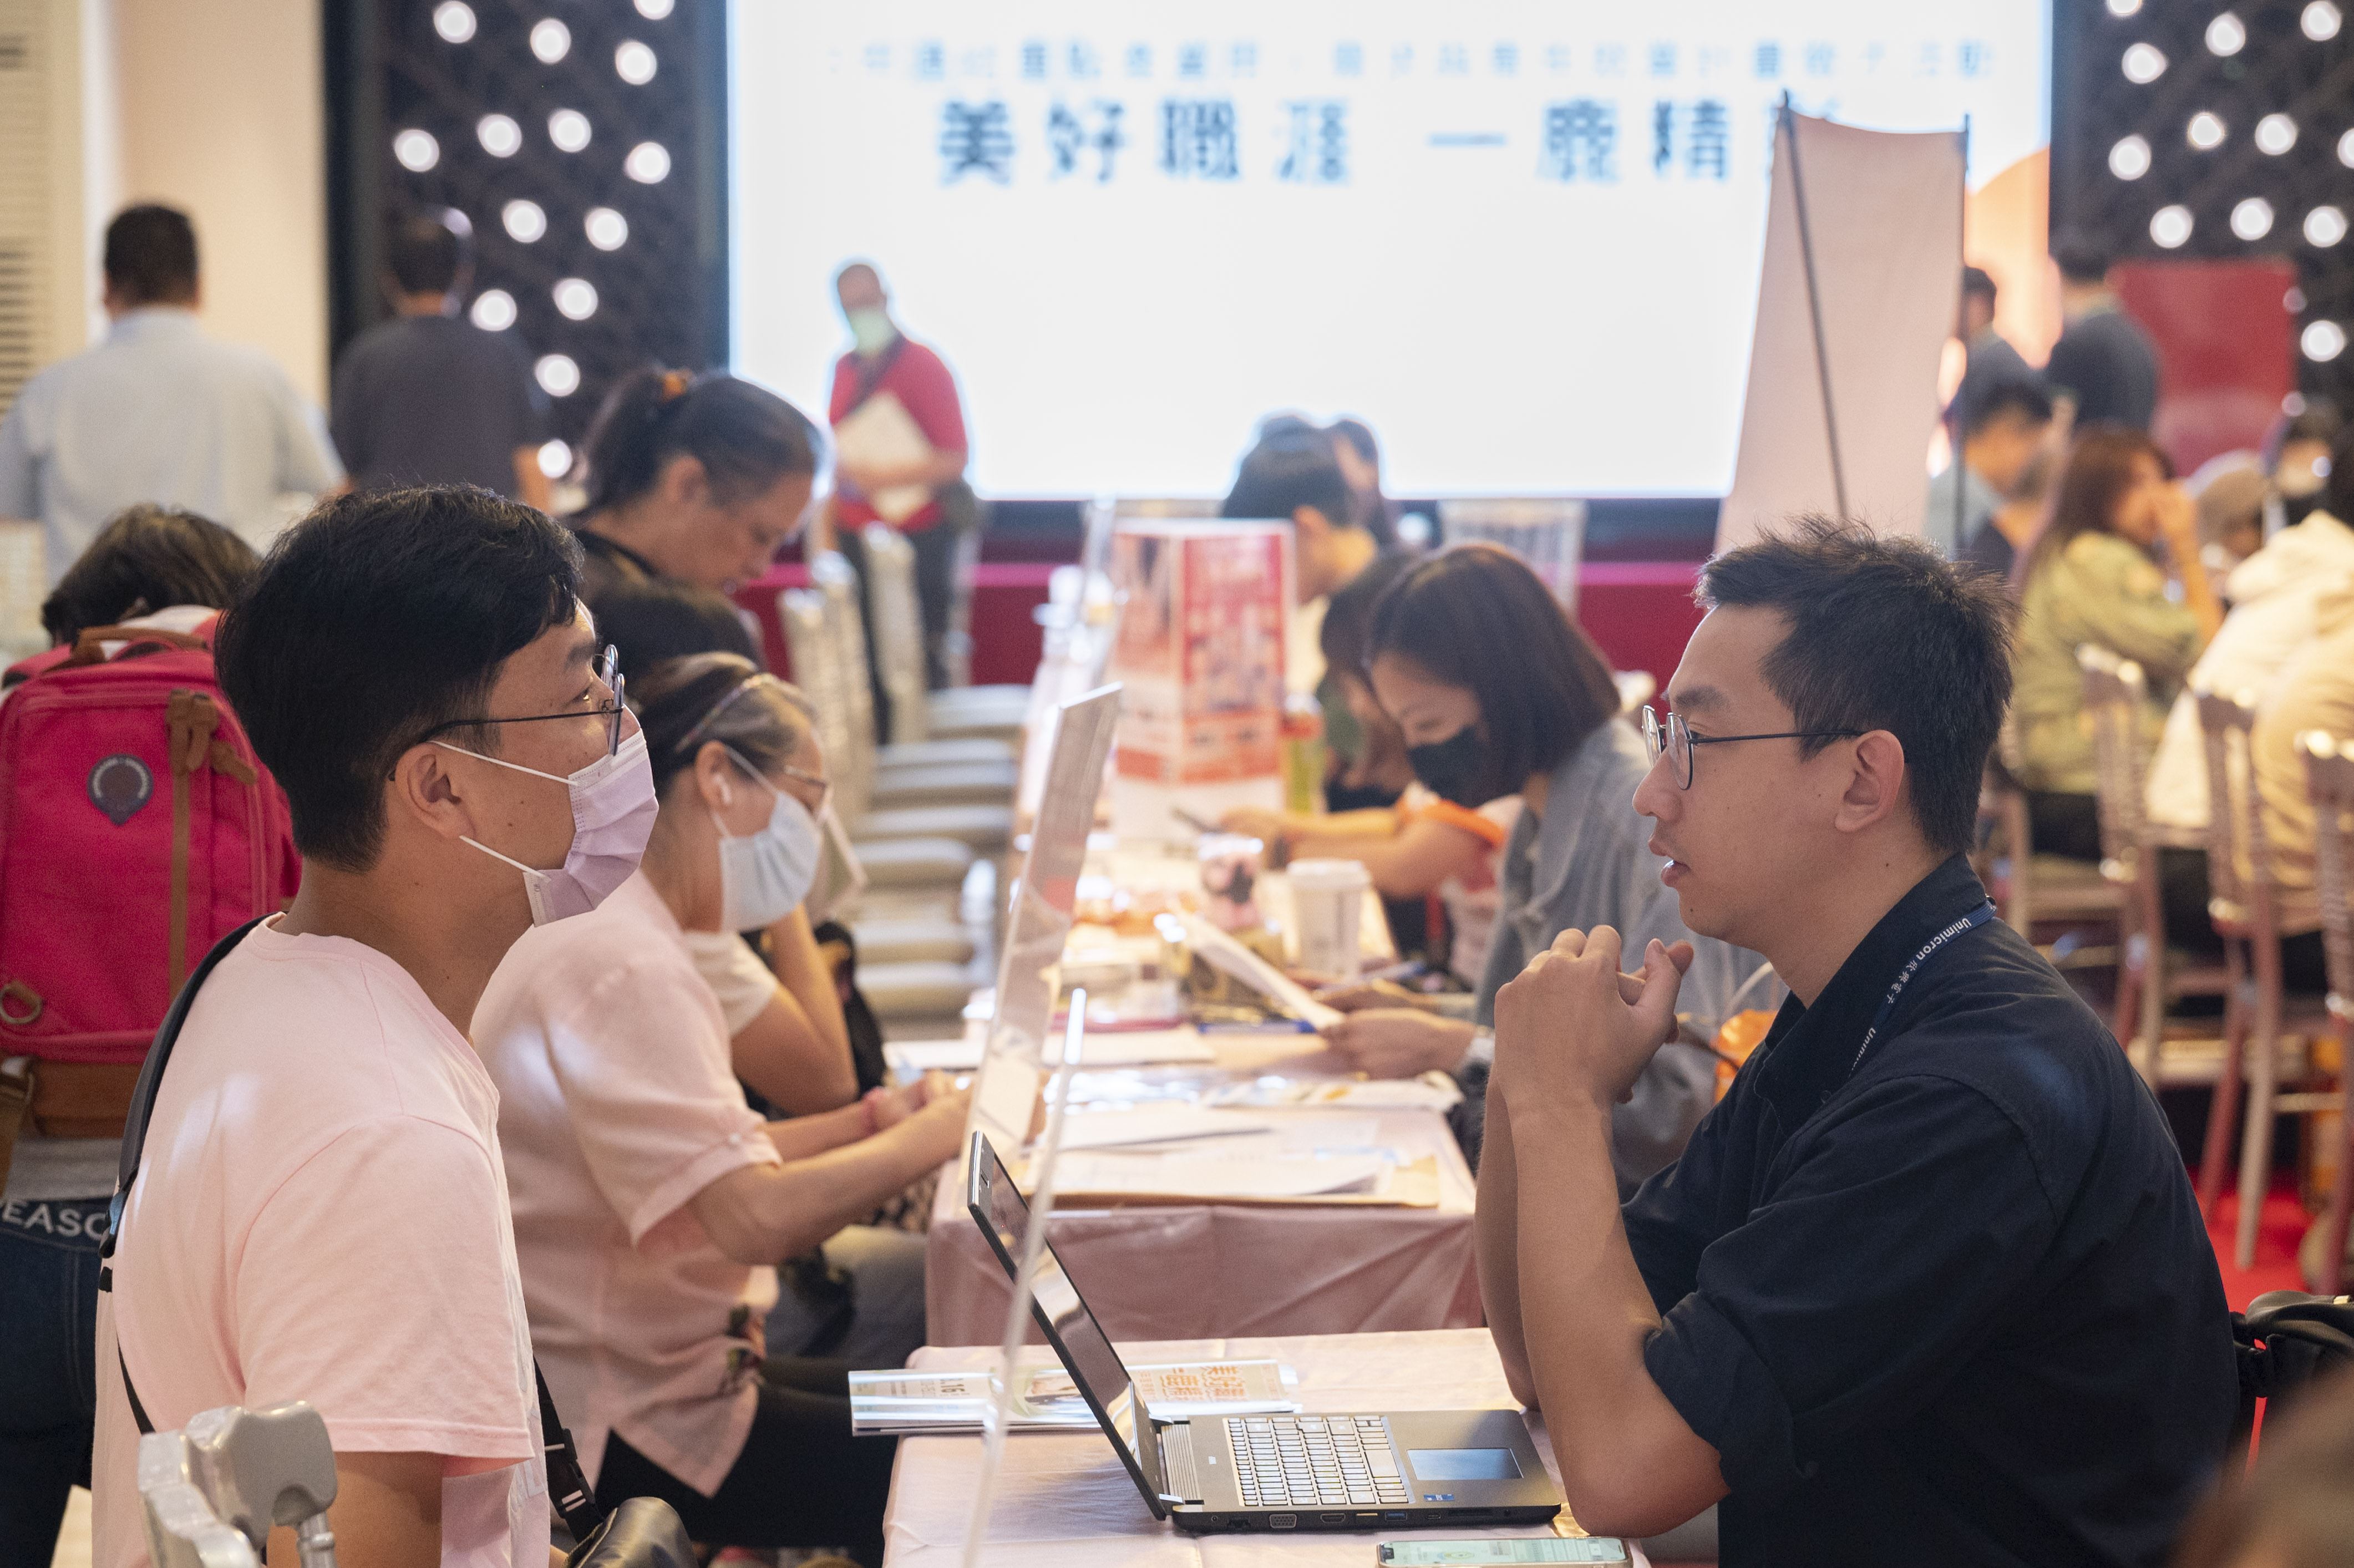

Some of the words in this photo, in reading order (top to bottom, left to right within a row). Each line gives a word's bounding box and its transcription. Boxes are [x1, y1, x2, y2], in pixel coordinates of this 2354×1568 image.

[938, 97, 1350, 185] 美好職涯
[1916, 917, 1971, 960] Unimicron
[1886, 960, 1917, 1004] 欣興電子
